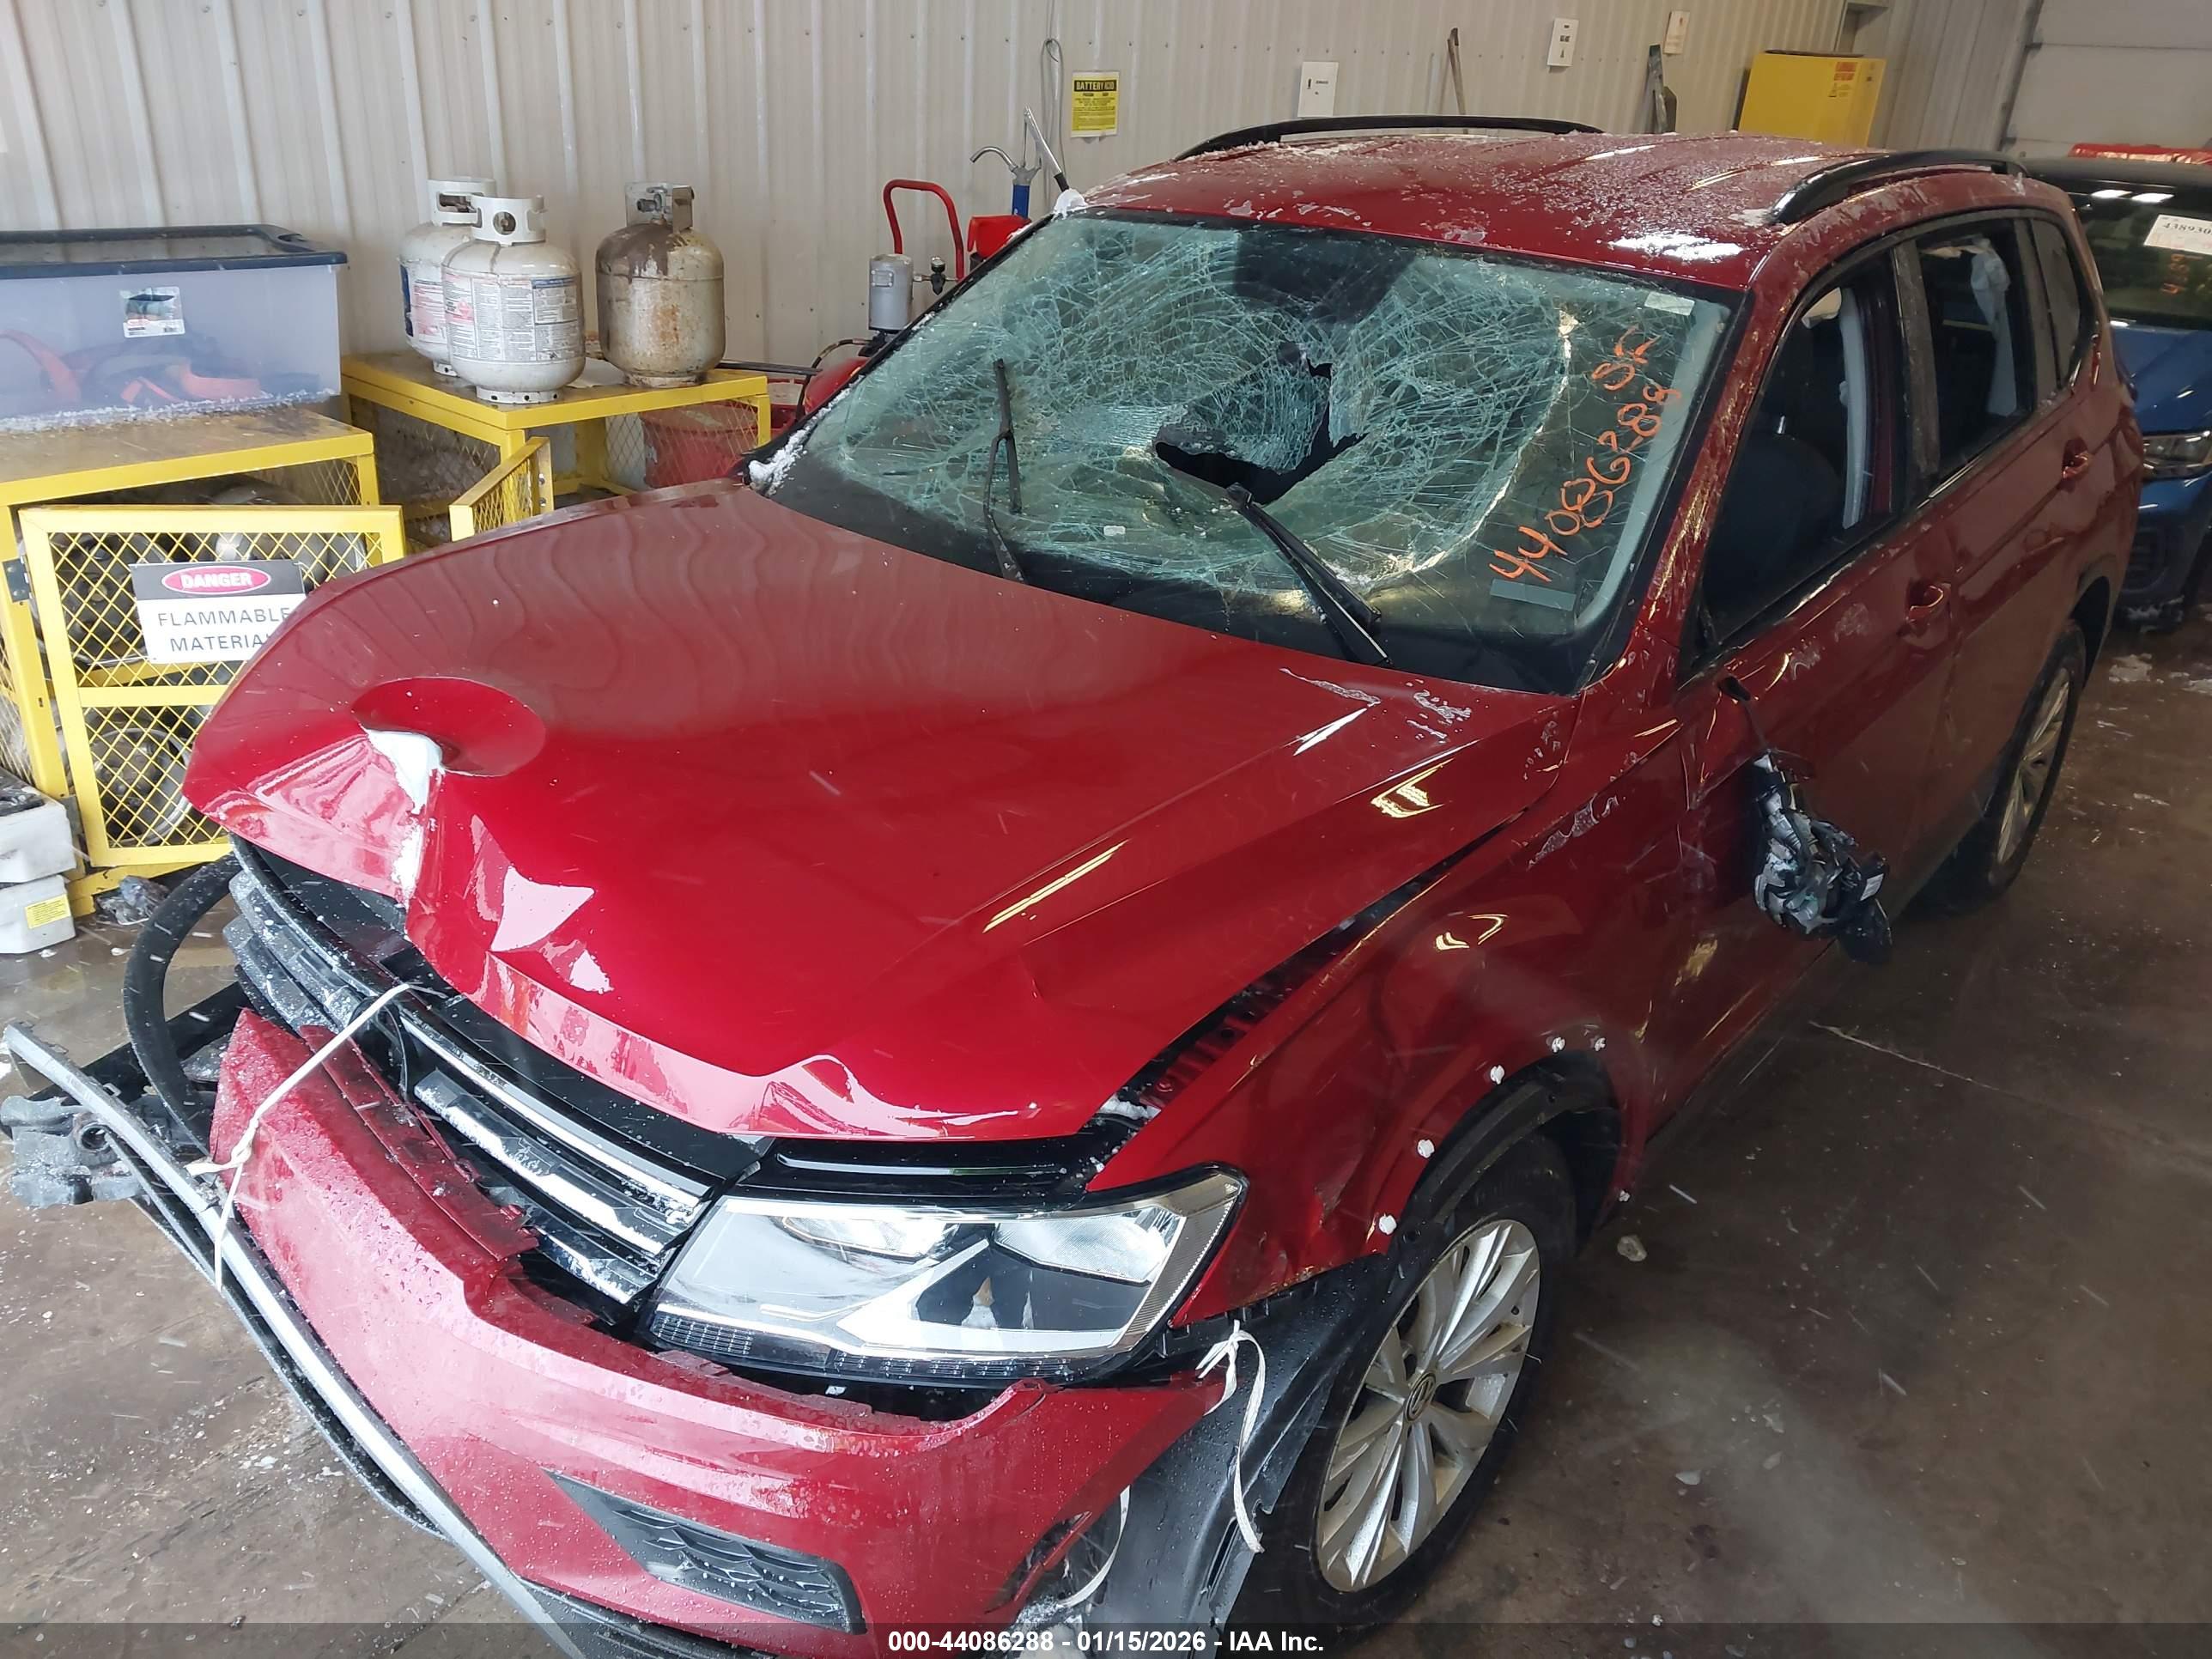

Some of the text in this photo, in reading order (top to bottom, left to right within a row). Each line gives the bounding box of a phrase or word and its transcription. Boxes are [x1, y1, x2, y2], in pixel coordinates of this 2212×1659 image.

[2162, 222, 2212, 235] 438930
[179, 571, 253, 589] DANGER
[157, 606, 290, 627] FLAMMABLE
[170, 634, 270, 653] MATERIA
